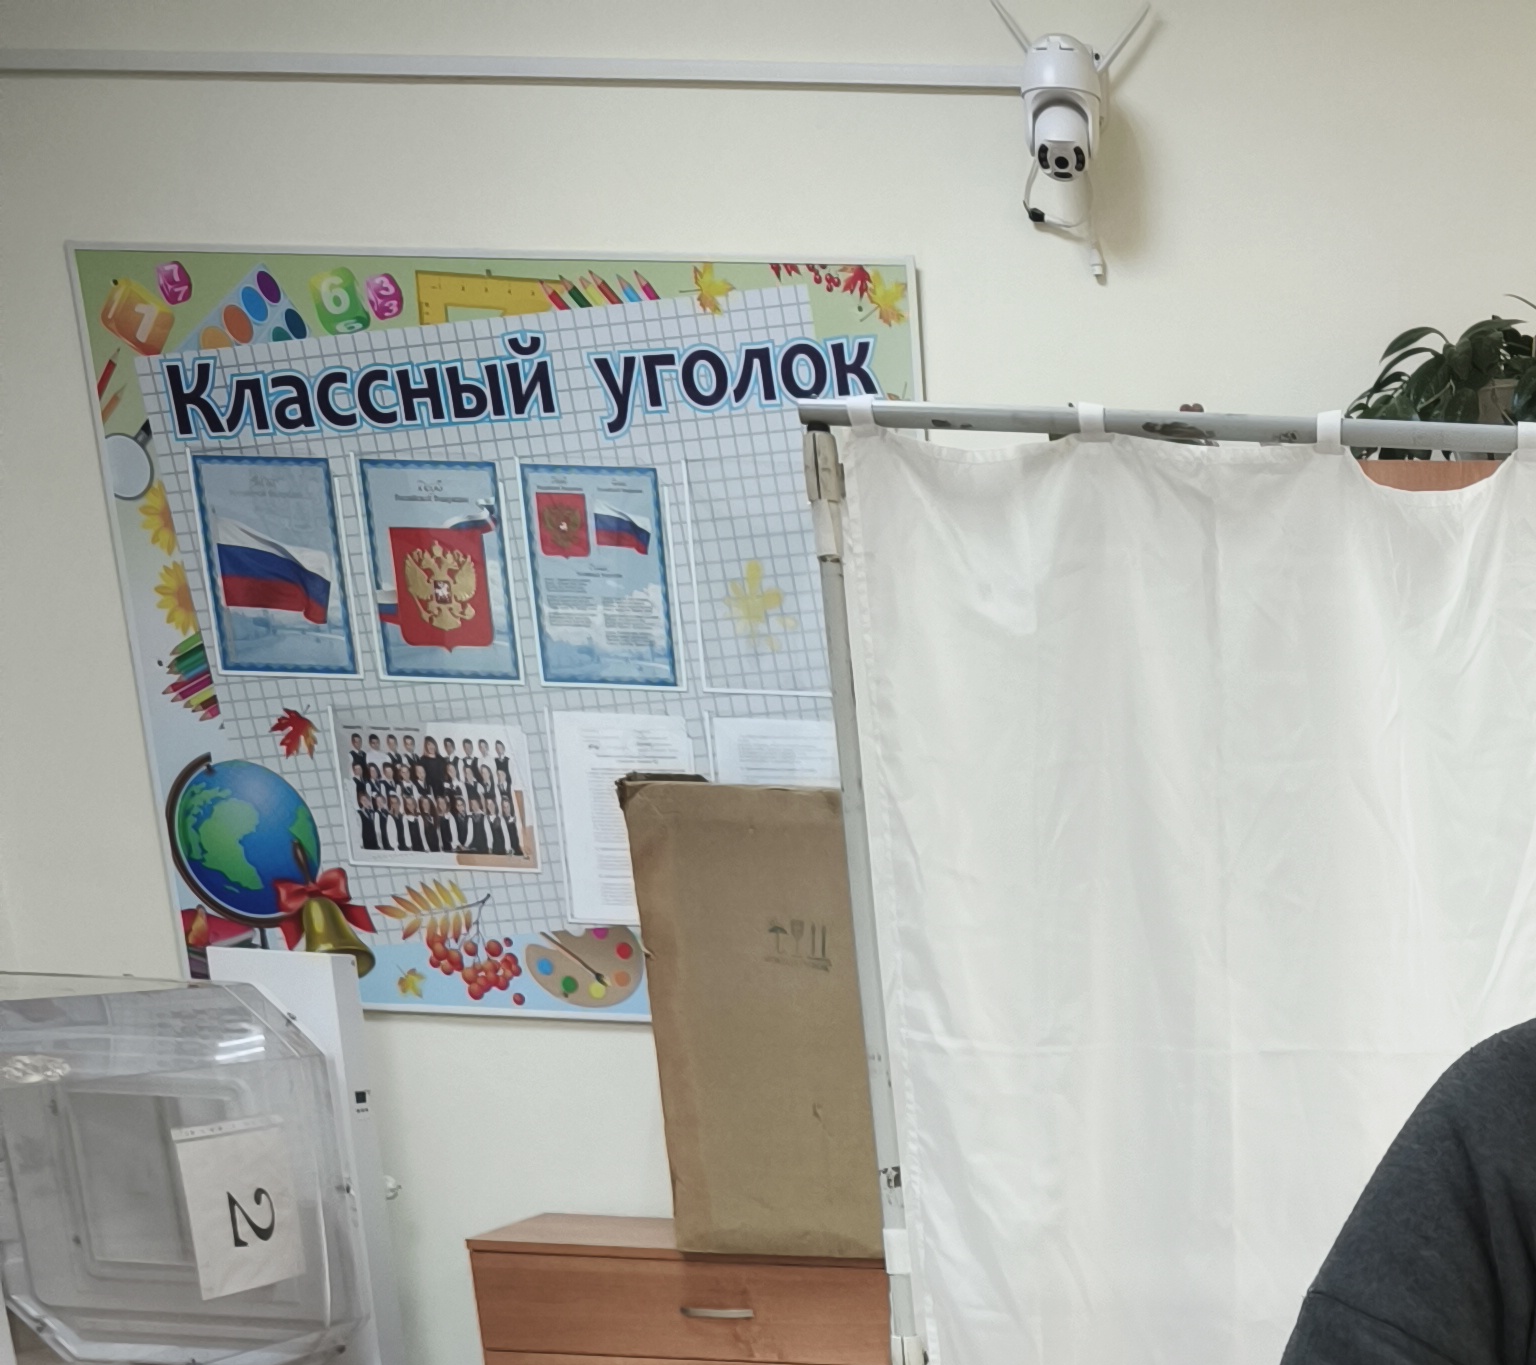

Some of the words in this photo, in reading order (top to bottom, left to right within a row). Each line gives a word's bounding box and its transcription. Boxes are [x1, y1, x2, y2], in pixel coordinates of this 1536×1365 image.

[320, 275, 351, 315] 6
[375, 276, 395, 296] 3
[384, 300, 399, 317] 3
[164, 335, 557, 436] Классный
[591, 340, 880, 434] уголок
[226, 1187, 276, 1248] 2
